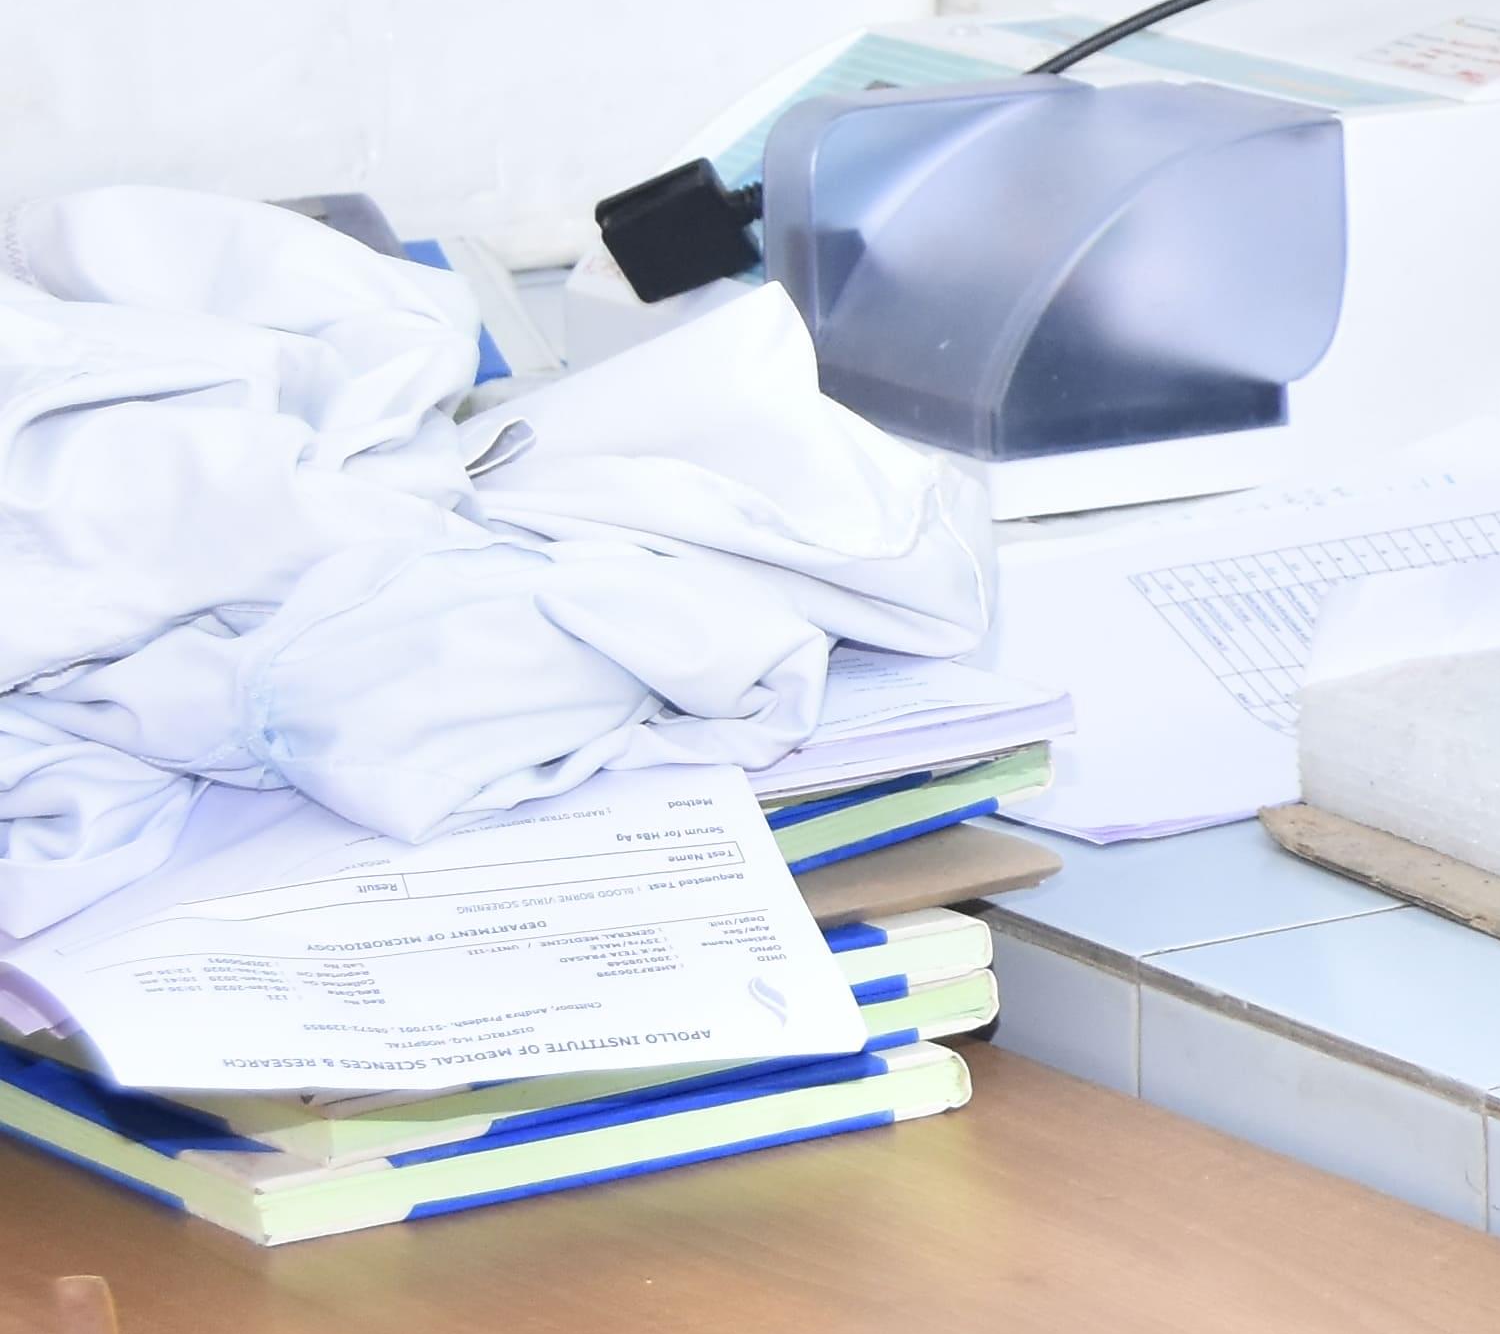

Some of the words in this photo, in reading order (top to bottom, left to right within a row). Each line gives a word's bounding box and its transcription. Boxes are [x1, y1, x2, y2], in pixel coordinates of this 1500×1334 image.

[668, 798, 713, 810] Method
[636, 832, 661, 842] HBs
[662, 829, 682, 838] for
[683, 826, 724, 837] Serum
[616, 835, 634, 843] Ag
[668, 854, 704, 864] Name
[707, 850, 734, 860] Test
[648, 880, 676, 891] Test
[678, 872, 744, 887] Requested
[357, 882, 398, 895] Result
[456, 898, 520, 914] SCREENING
[428, 931, 446, 942] OF
[450, 920, 547, 940] DEPARTMENT
[606, 927, 656, 940] GENERAL
[306, 935, 423, 952] MICROBIOLOGY
[538, 934, 601, 948] MEDICINE
[505, 1007, 548, 1020] Andhra
[477, 1025, 536, 1042] DISTRICT
[645, 1029, 711, 1045] APOLLO
[384, 1039, 447, 1050] HOSPITAL
[518, 1044, 541, 1057] OF
[546, 1035, 639, 1054] INSTITUTE
[222, 1058, 316, 1068] RESEARCH
[431, 1047, 513, 1067] MEDICAL
[340, 1058, 427, 1071] SCIENCES
